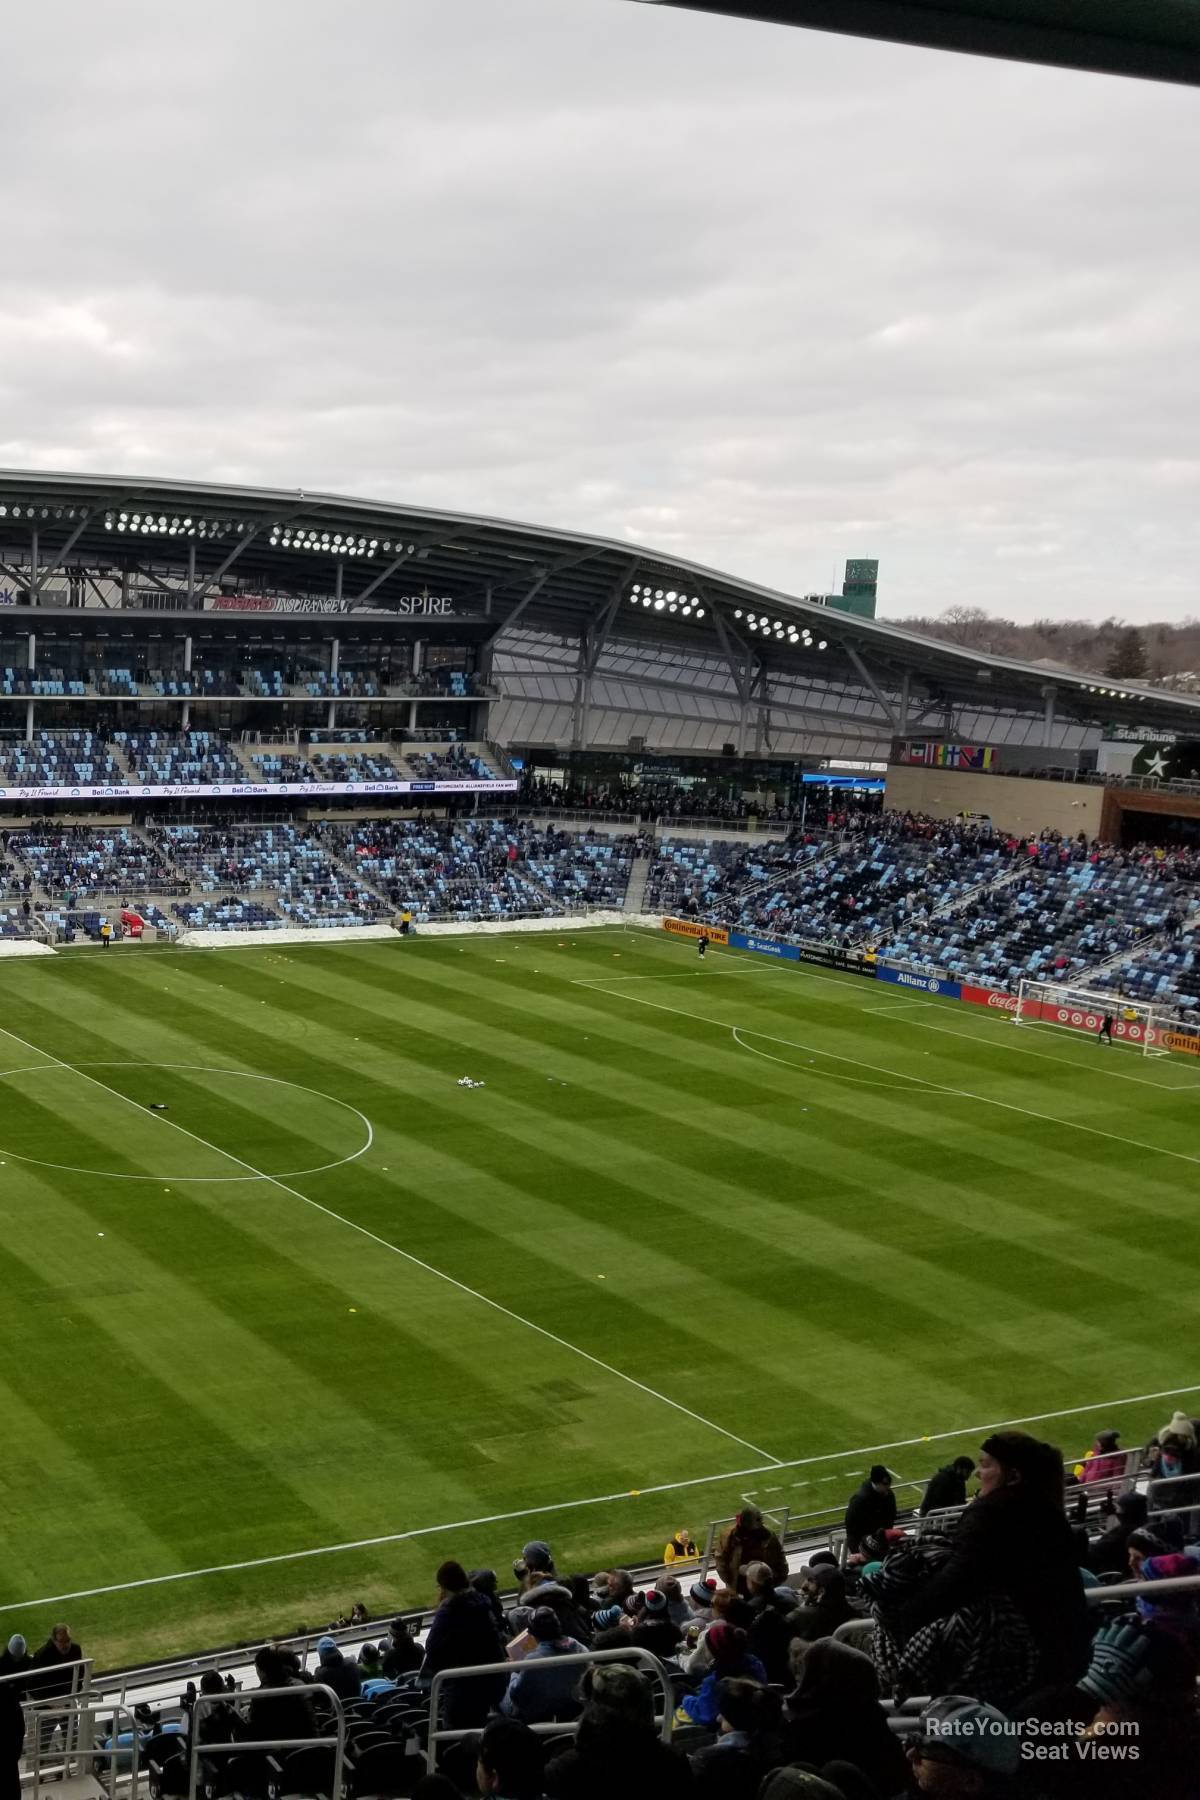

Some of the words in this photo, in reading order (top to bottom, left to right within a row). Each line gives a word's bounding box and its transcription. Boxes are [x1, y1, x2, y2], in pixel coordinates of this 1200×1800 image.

[400, 596, 455, 615] SPIRE
[710, 931, 726, 941] TIRE
[898, 973, 927, 988] Allianz
